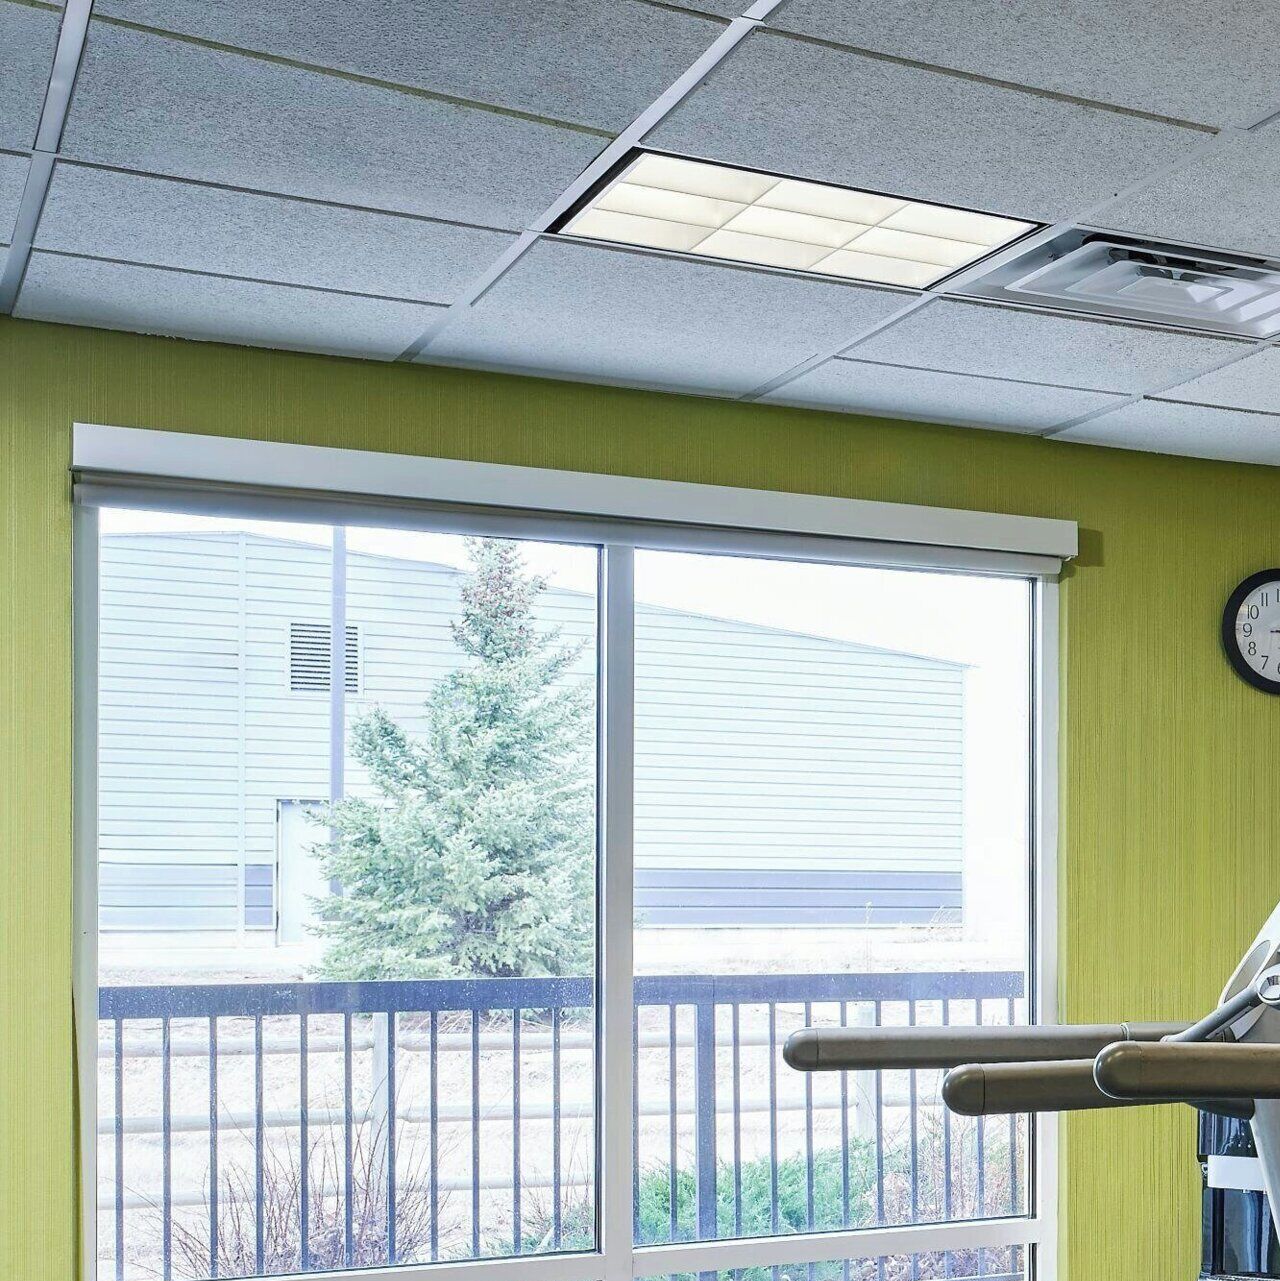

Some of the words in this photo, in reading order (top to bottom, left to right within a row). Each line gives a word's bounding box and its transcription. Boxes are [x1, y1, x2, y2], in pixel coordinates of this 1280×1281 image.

[1261, 592, 1268, 606] 11
[1247, 604, 1259, 620] 10
[1242, 623, 1252, 637] 9
[1248, 641, 1257, 655] 8
[1261, 655, 1269, 670] 7
